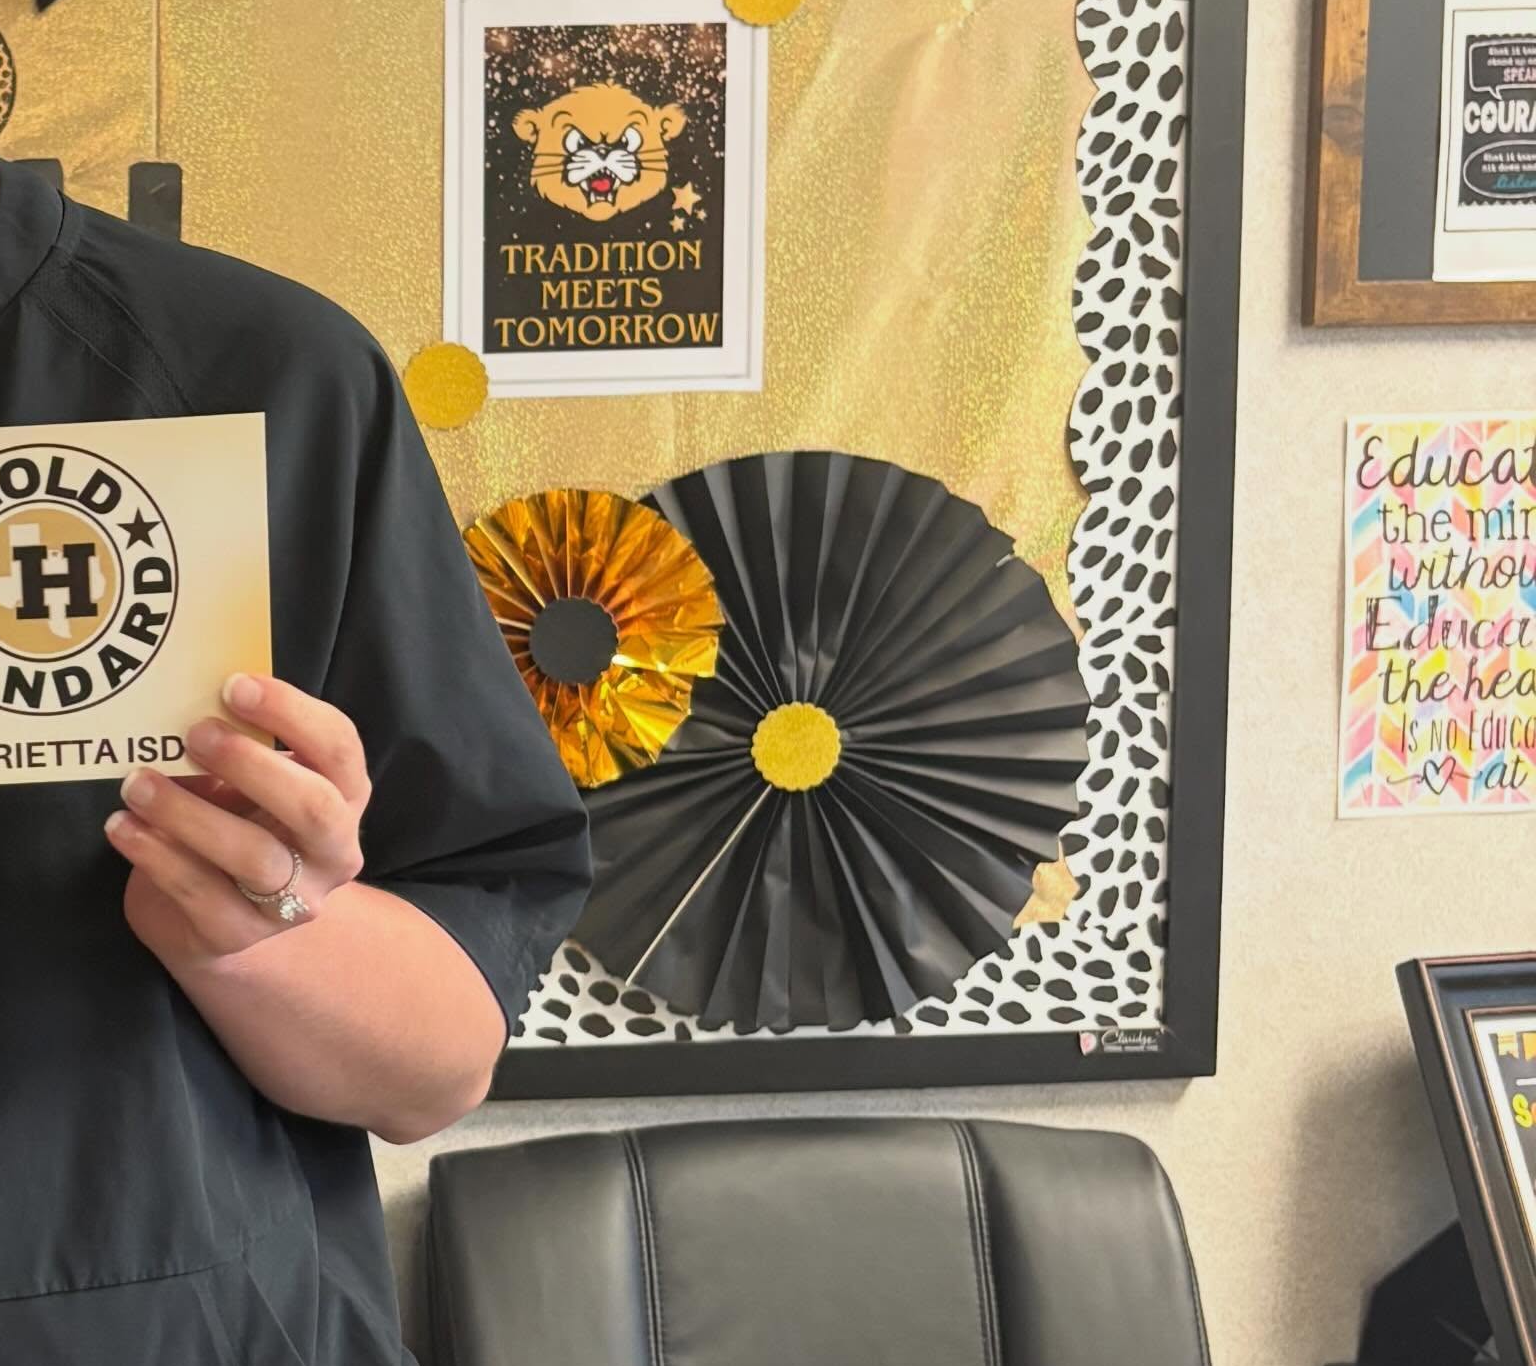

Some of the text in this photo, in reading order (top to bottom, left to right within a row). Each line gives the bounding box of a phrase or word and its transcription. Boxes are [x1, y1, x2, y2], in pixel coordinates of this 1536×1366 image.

[500, 239, 704, 275] TRADITION
[541, 277, 665, 311] MEETS
[494, 312, 719, 348] TOMORROW
[1377, 499, 1452, 544] the
[12, 542, 98, 621] H
[1378, 657, 1457, 705] the
[127, 735, 185, 764] ISD
[1484, 754, 1529, 791] at
